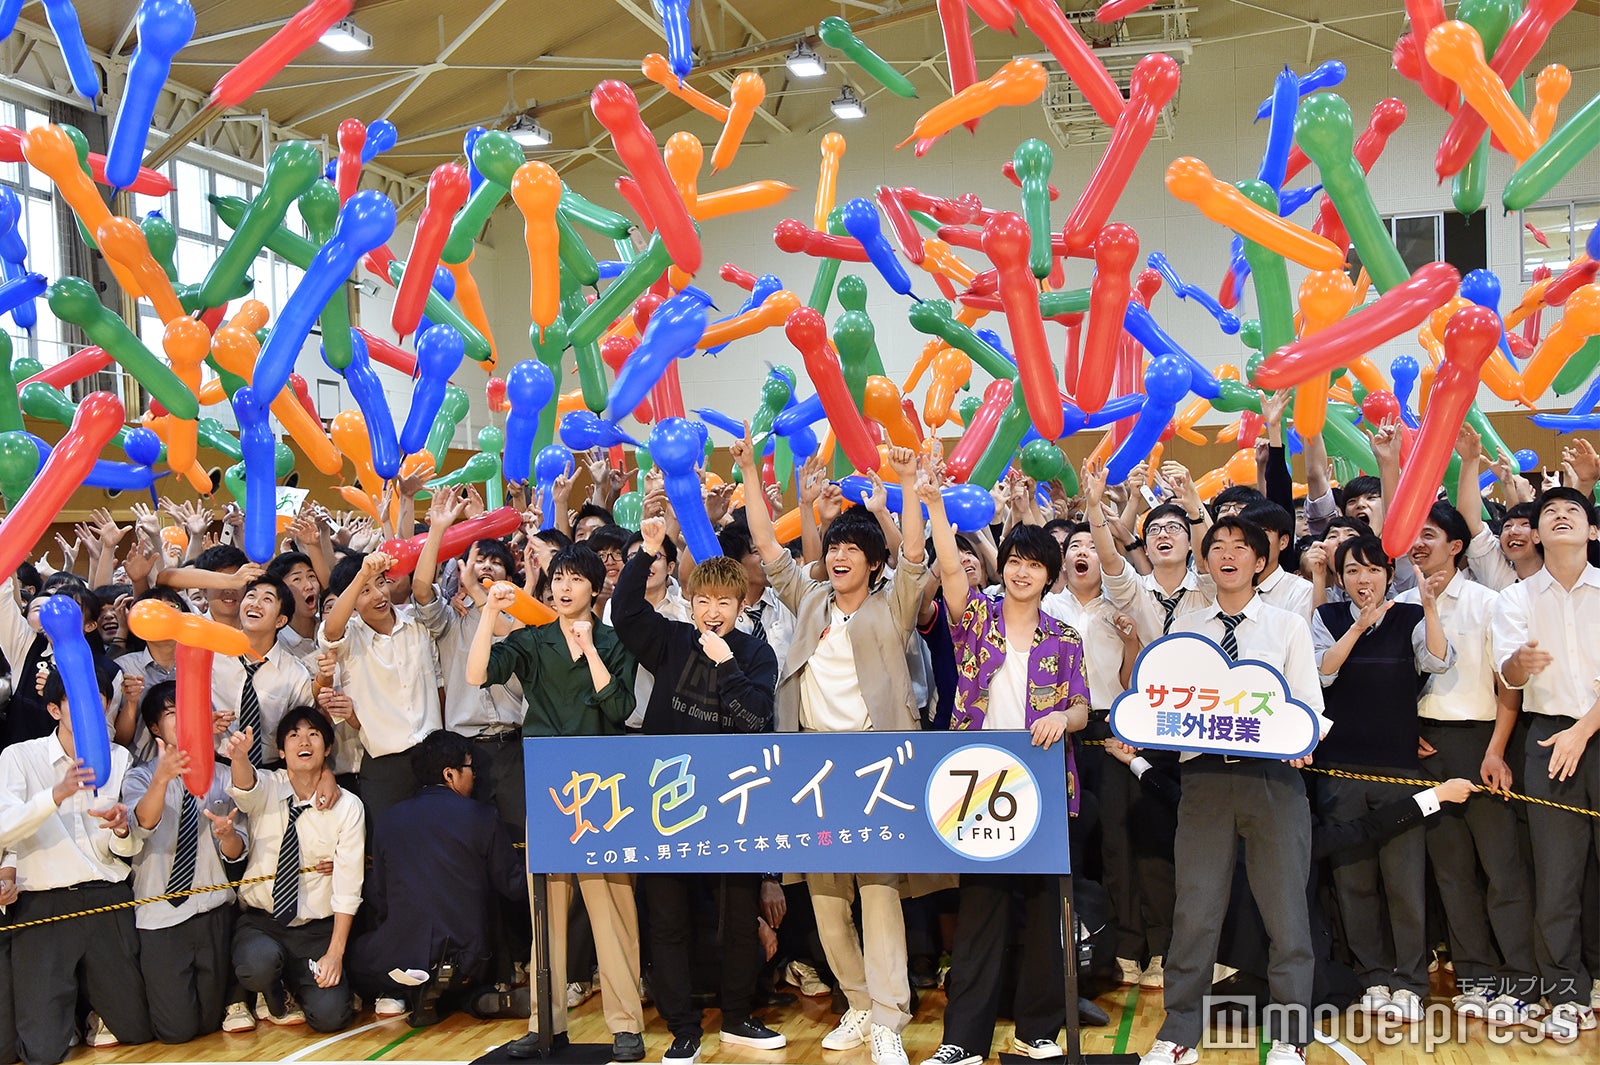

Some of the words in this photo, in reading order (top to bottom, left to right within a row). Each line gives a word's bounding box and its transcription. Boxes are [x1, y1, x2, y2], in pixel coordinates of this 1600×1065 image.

[672, 696, 687, 713] the
[1146, 684, 1276, 716] サプライズ
[1156, 711, 1261, 743] 課外授業
[548, 739, 917, 844] 虹色デイズ
[949, 769, 1018, 822] 7.6
[585, 824, 907, 866] この夏、男子だって本気で恋をする。
